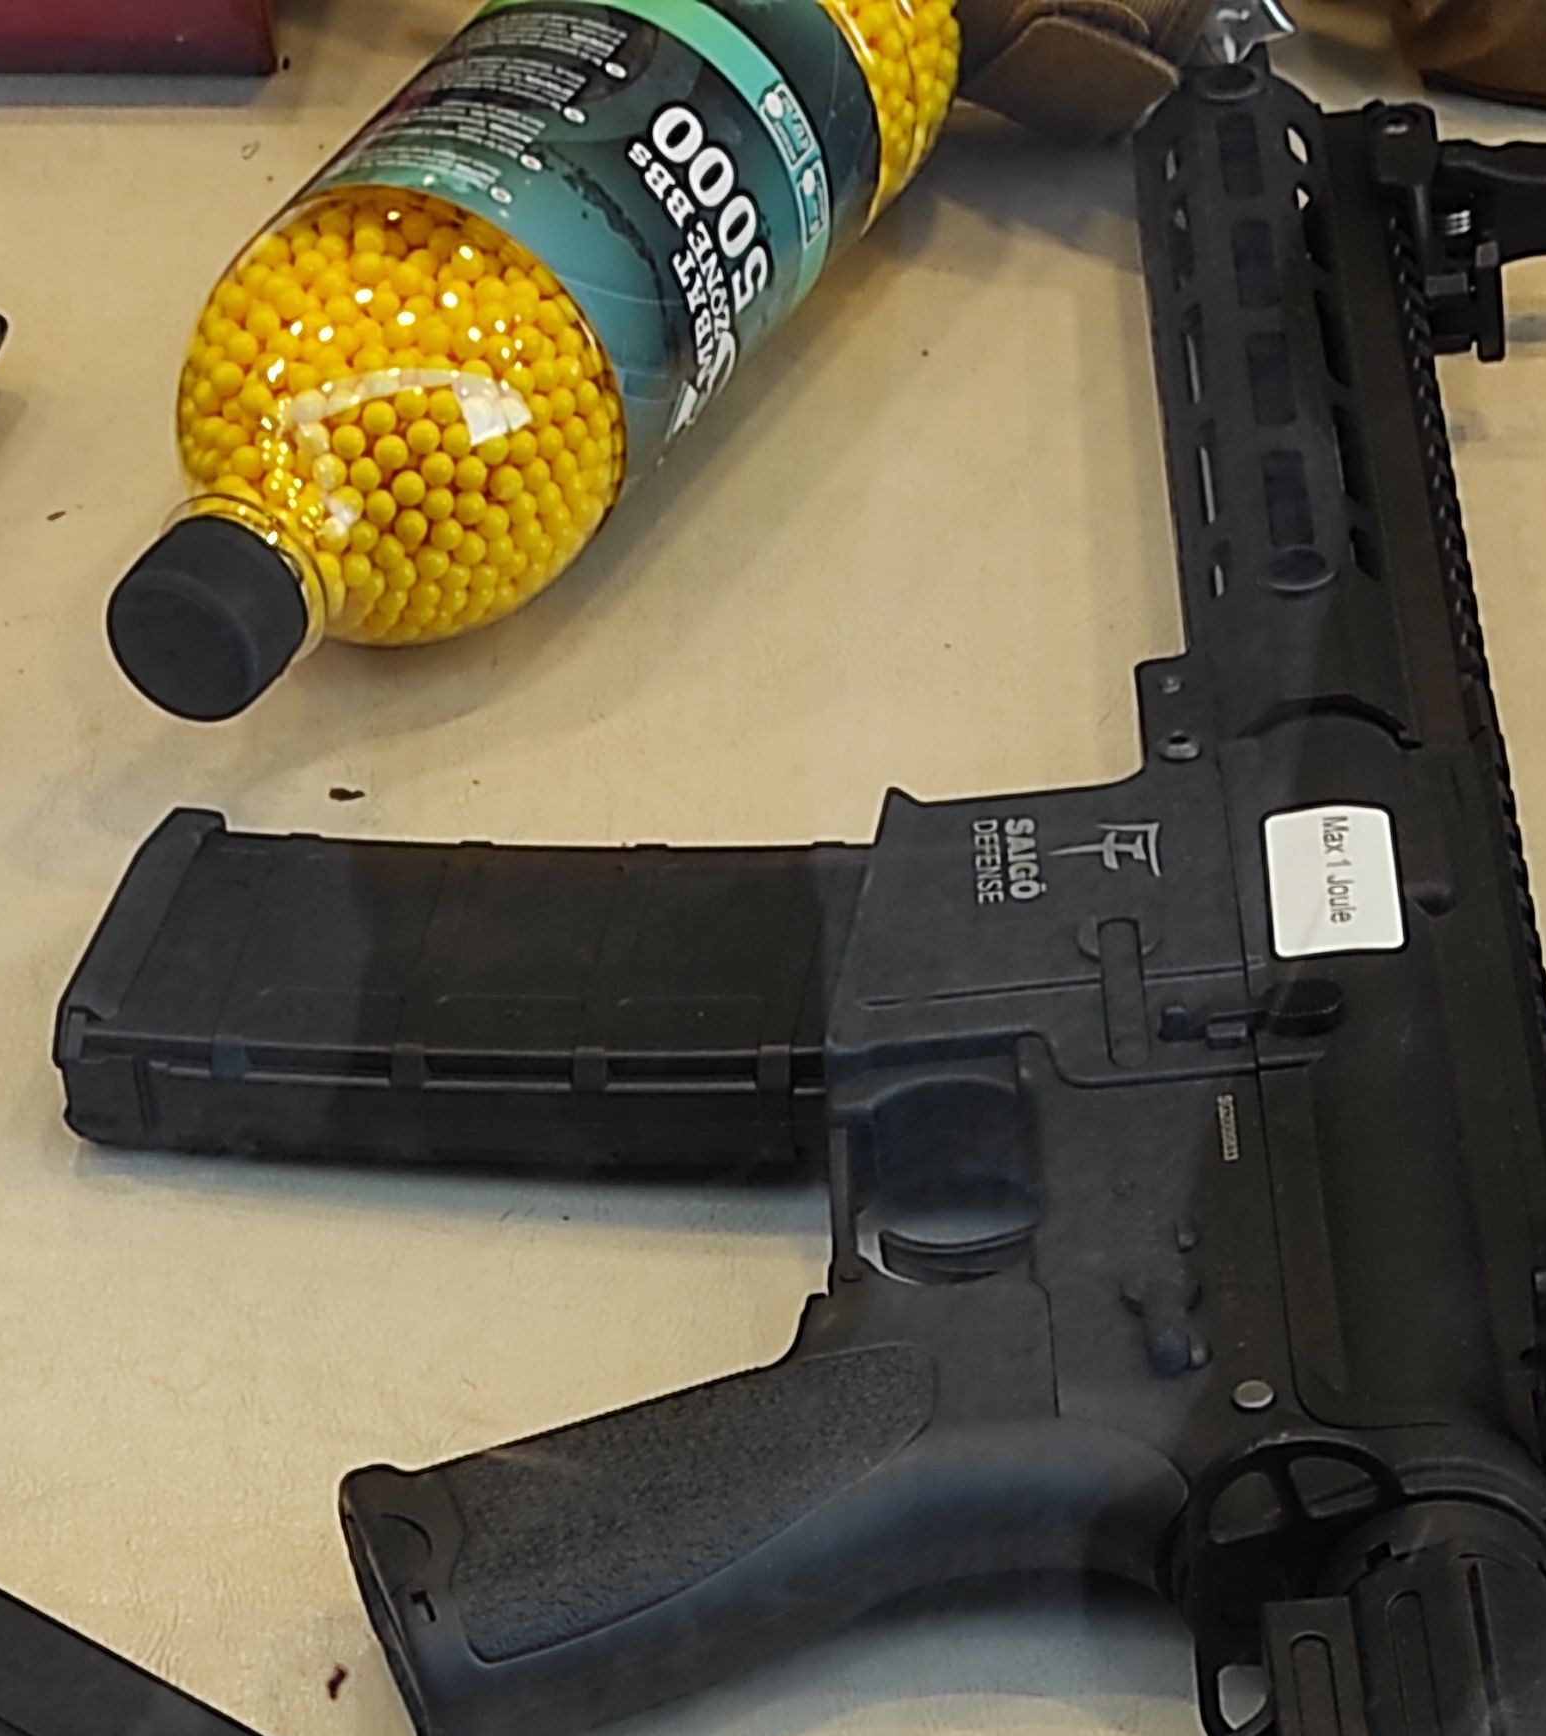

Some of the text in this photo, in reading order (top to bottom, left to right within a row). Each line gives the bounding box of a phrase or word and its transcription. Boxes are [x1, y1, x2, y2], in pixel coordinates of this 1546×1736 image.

[651, 106, 768, 315] 5000
[688, 221, 732, 340] ZONE
[972, 818, 1004, 904] DEFENSE
[1322, 815, 1348, 854] Max
[1327, 874, 1355, 924] Joule
